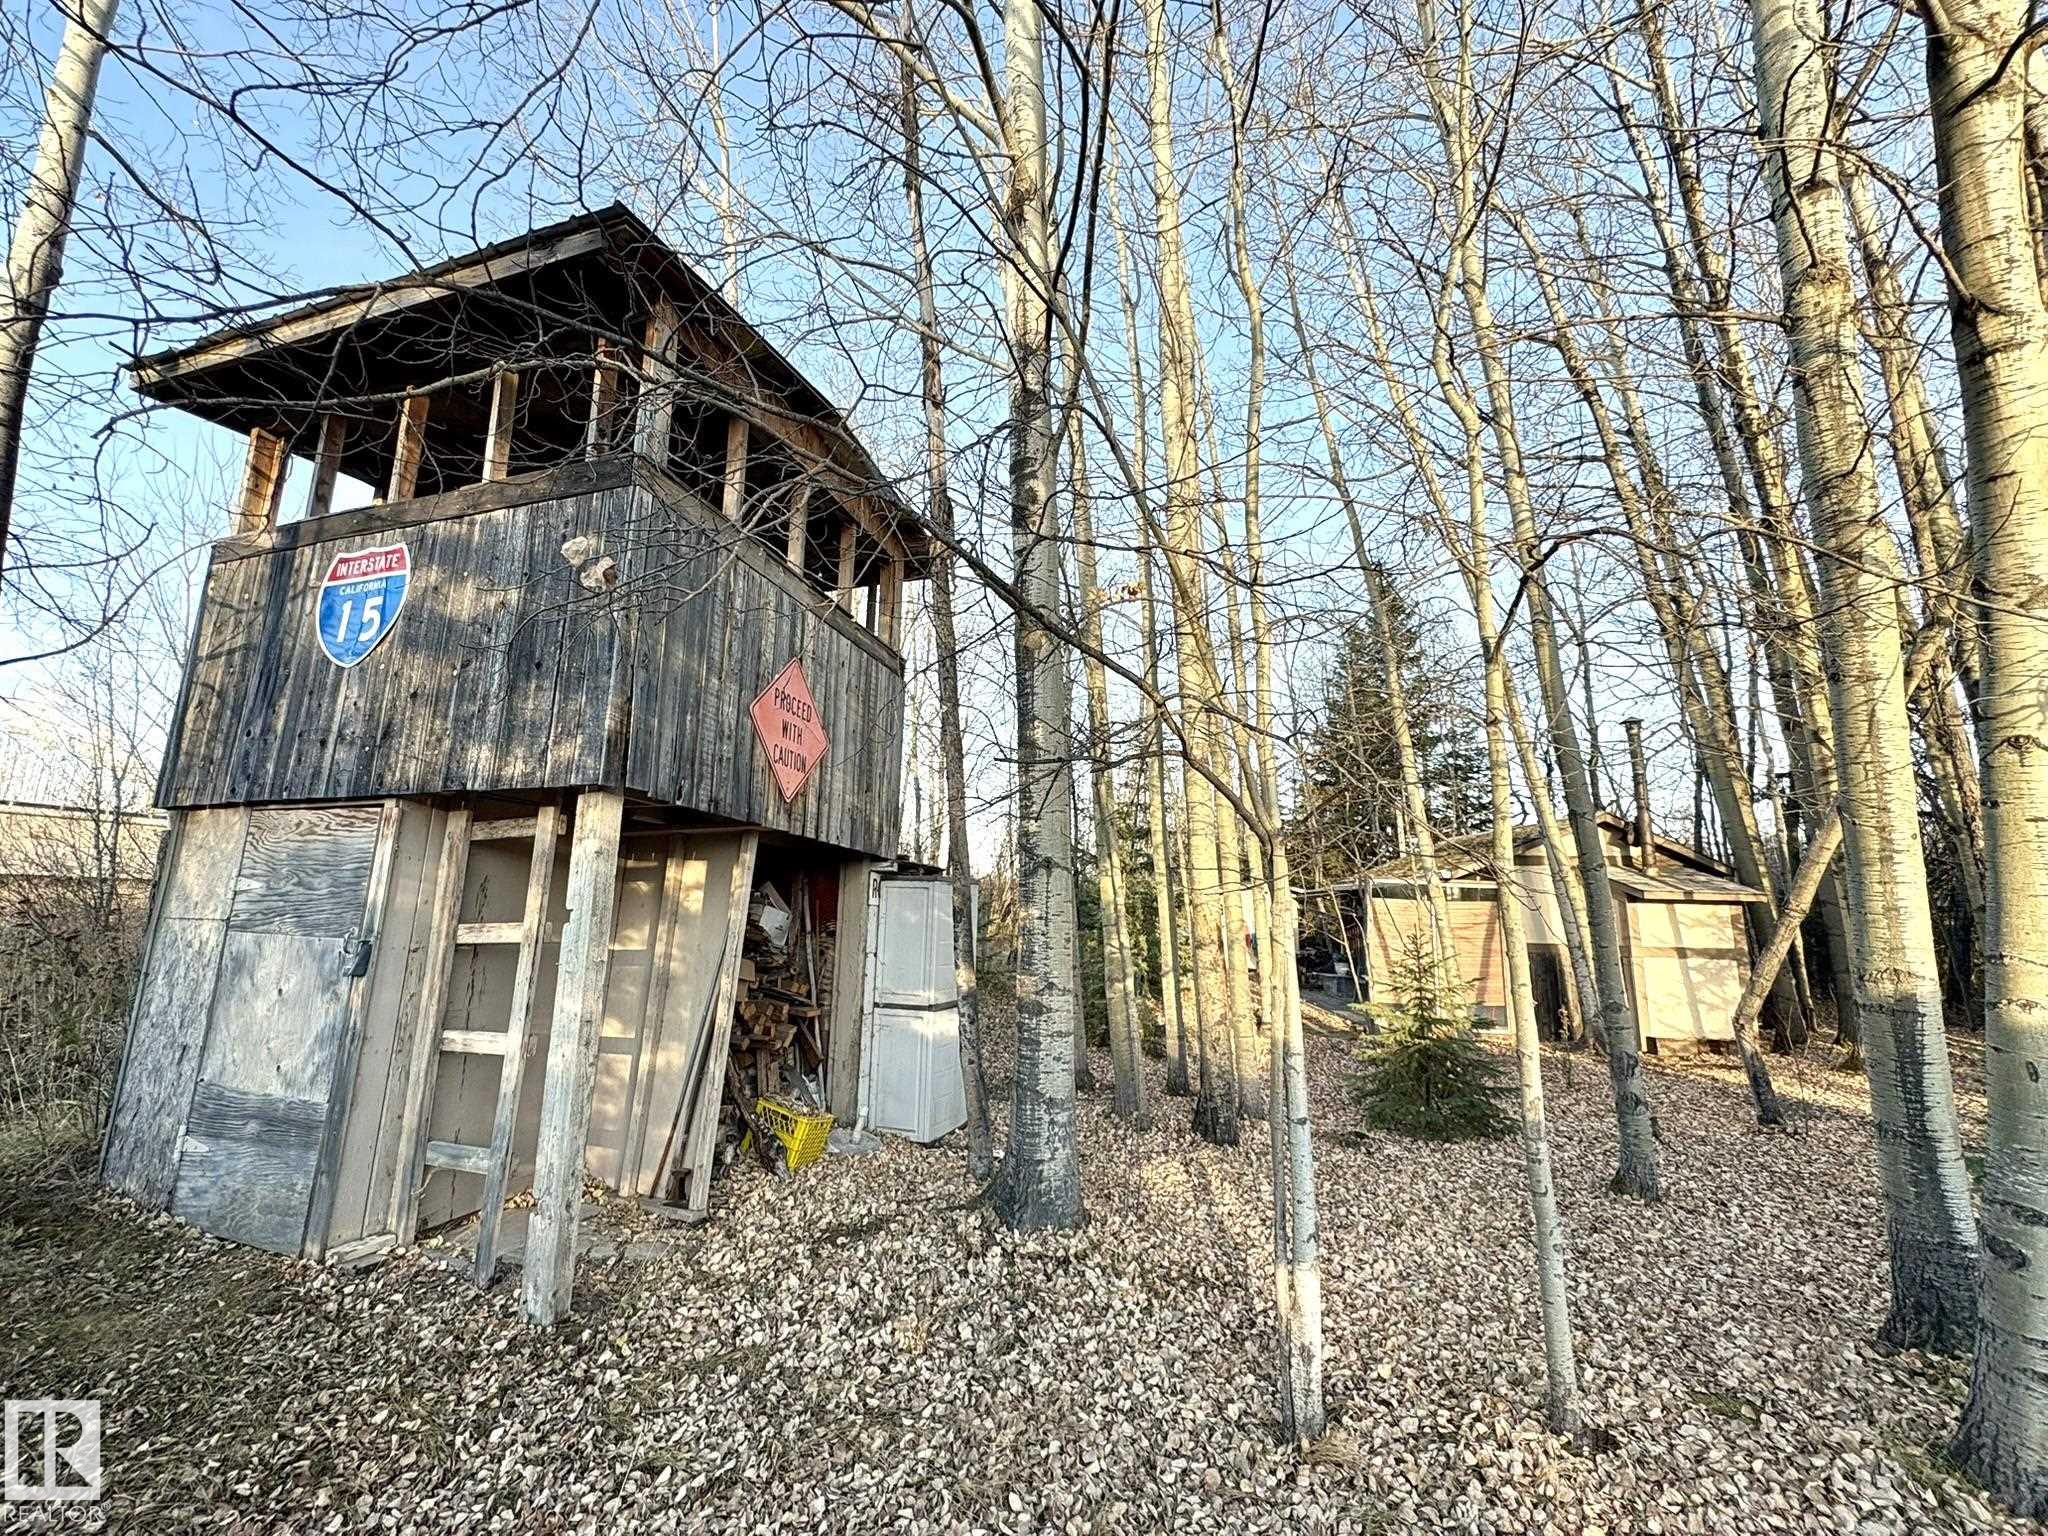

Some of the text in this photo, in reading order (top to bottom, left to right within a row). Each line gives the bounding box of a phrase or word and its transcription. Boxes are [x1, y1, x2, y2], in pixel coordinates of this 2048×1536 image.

[336, 553, 400, 577] INTERSTATE
[339, 579, 387, 596] CALIFORNIA
[336, 595, 384, 643] 15
[774, 687, 812, 723] PROCEED
[781, 719, 803, 746] WITH
[773, 743, 807, 774] CAUTION
